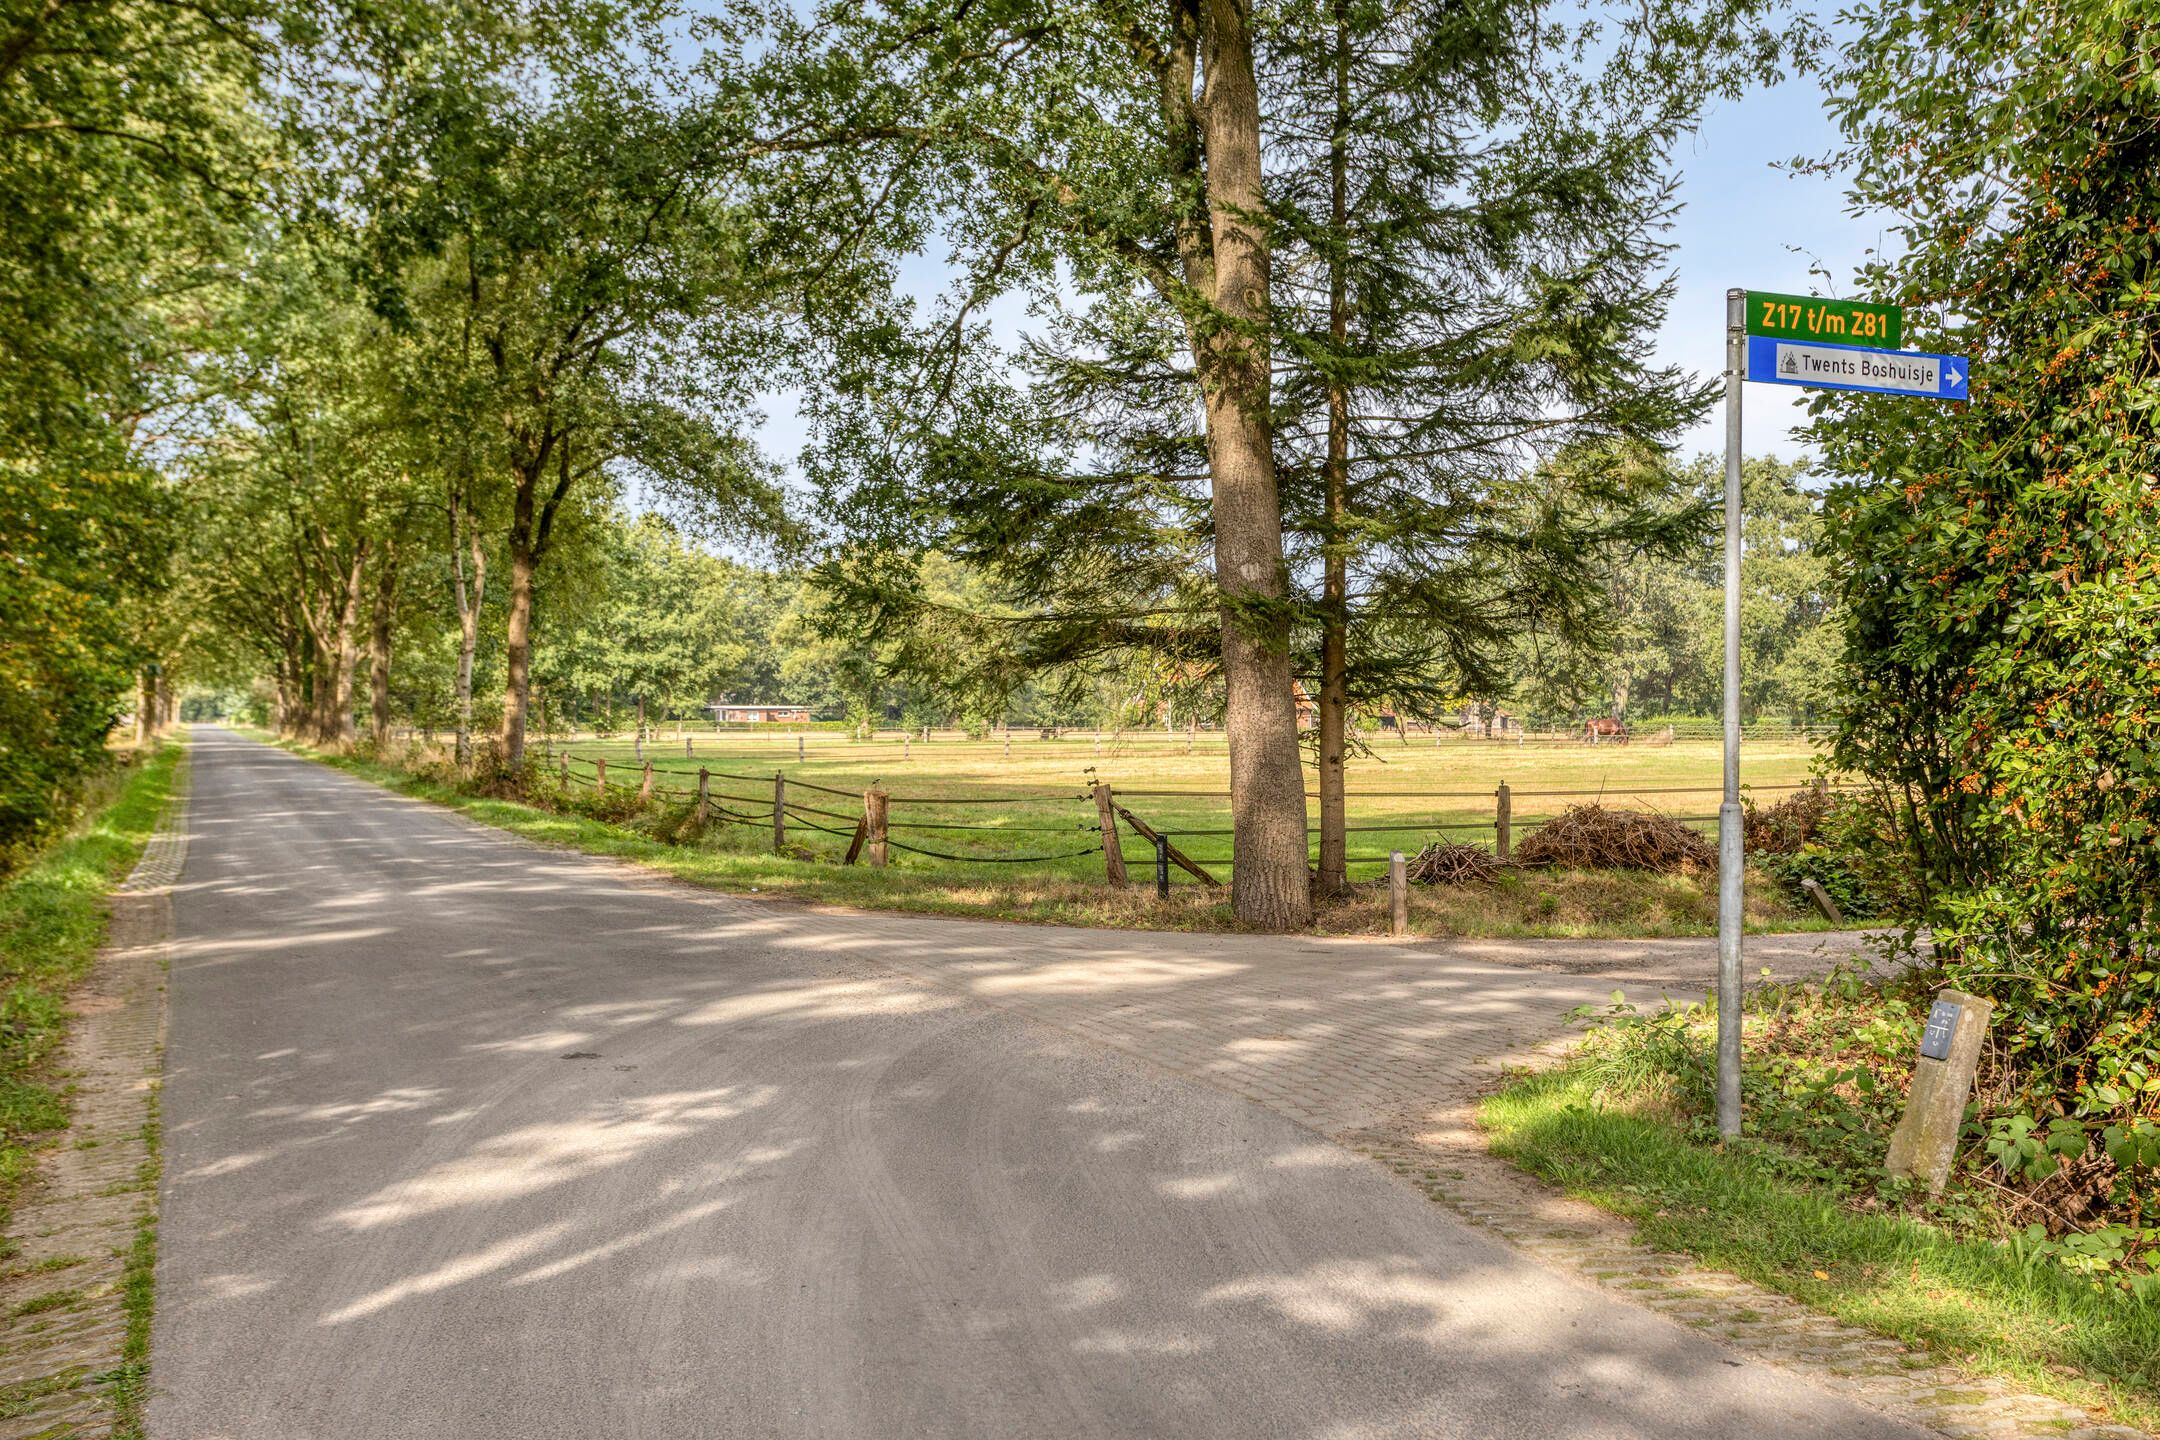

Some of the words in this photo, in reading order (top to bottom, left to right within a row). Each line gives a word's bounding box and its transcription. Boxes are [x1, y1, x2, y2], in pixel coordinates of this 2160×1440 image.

[1762, 302, 1801, 330] Z17
[1807, 306, 1845, 334] t/m
[1851, 311, 1887, 338] Z81
[1802, 354, 1855, 375] Twents
[1861, 360, 1934, 386] Boshuisje
